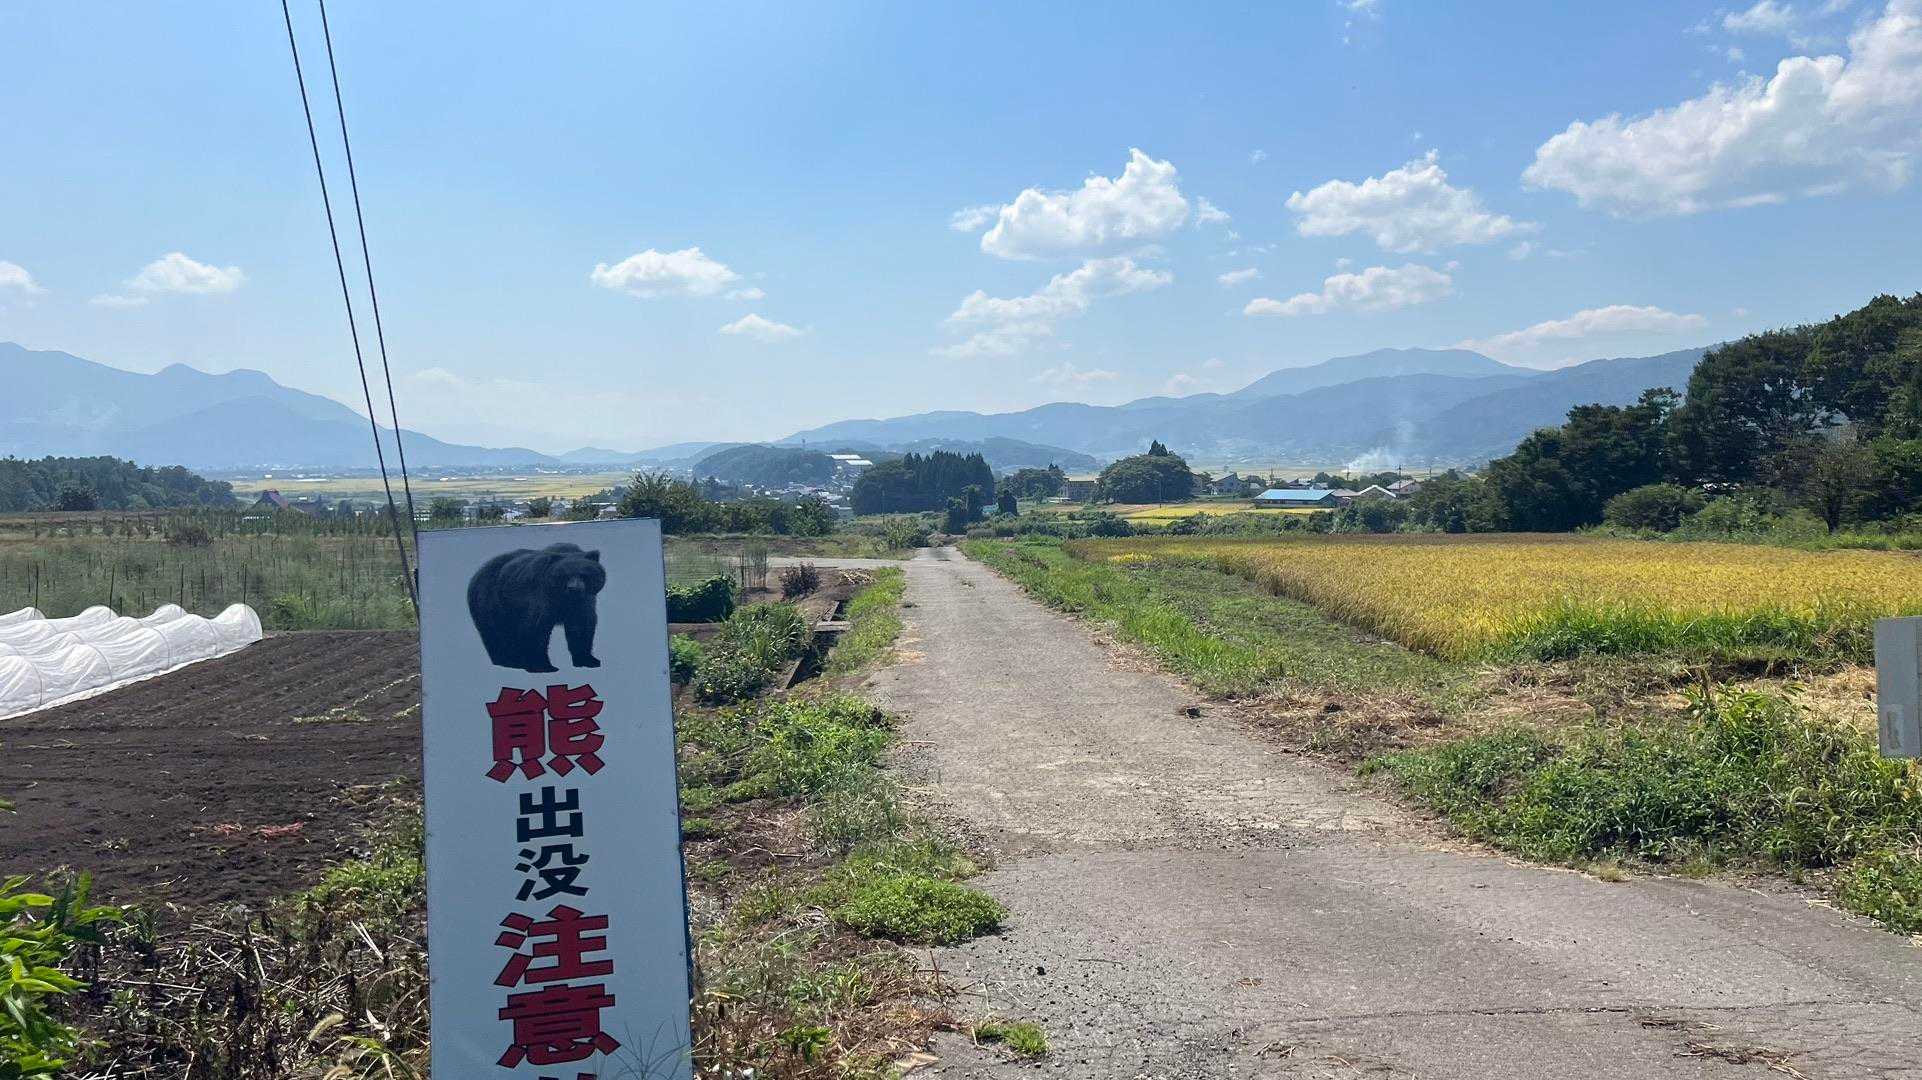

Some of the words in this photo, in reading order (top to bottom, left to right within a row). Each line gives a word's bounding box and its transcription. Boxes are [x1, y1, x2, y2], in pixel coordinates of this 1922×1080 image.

[486, 683, 620, 1080] 熊出没注意
